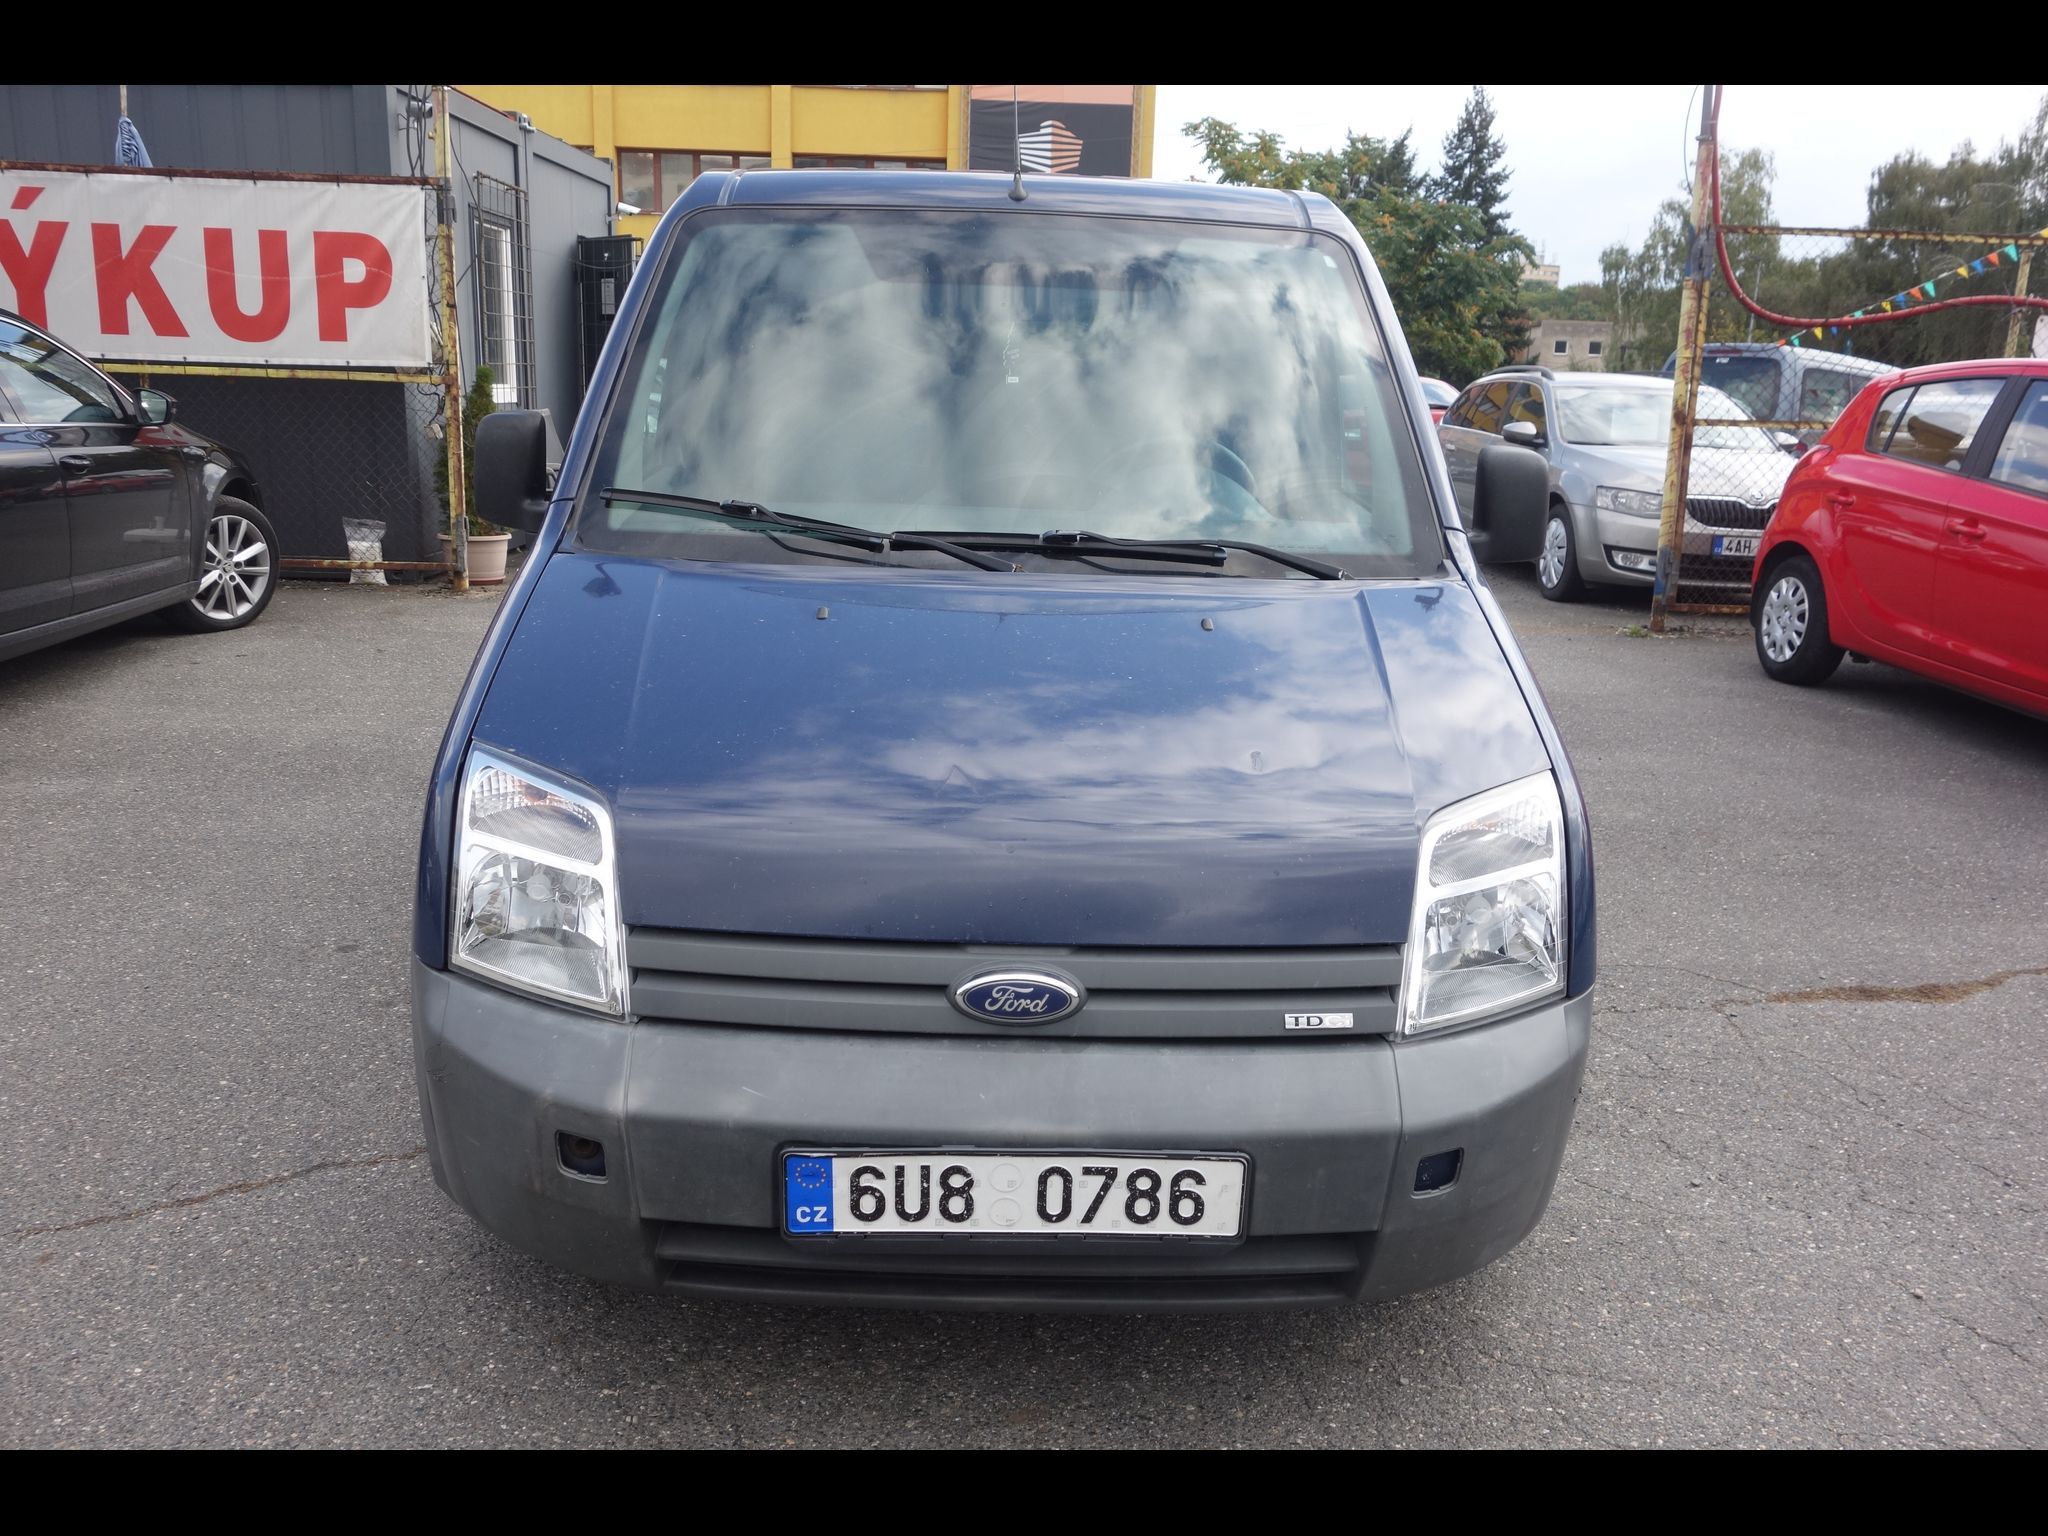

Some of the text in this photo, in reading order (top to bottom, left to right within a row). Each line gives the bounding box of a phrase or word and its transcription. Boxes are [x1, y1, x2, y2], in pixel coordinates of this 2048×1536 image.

[0, 186, 393, 343] ÝKUP
[1725, 539, 1752, 553] 4AH
[984, 985, 1050, 1013] Ford
[849, 1165, 1207, 1225] 6U8 0786
[795, 1205, 828, 1223] CZ
